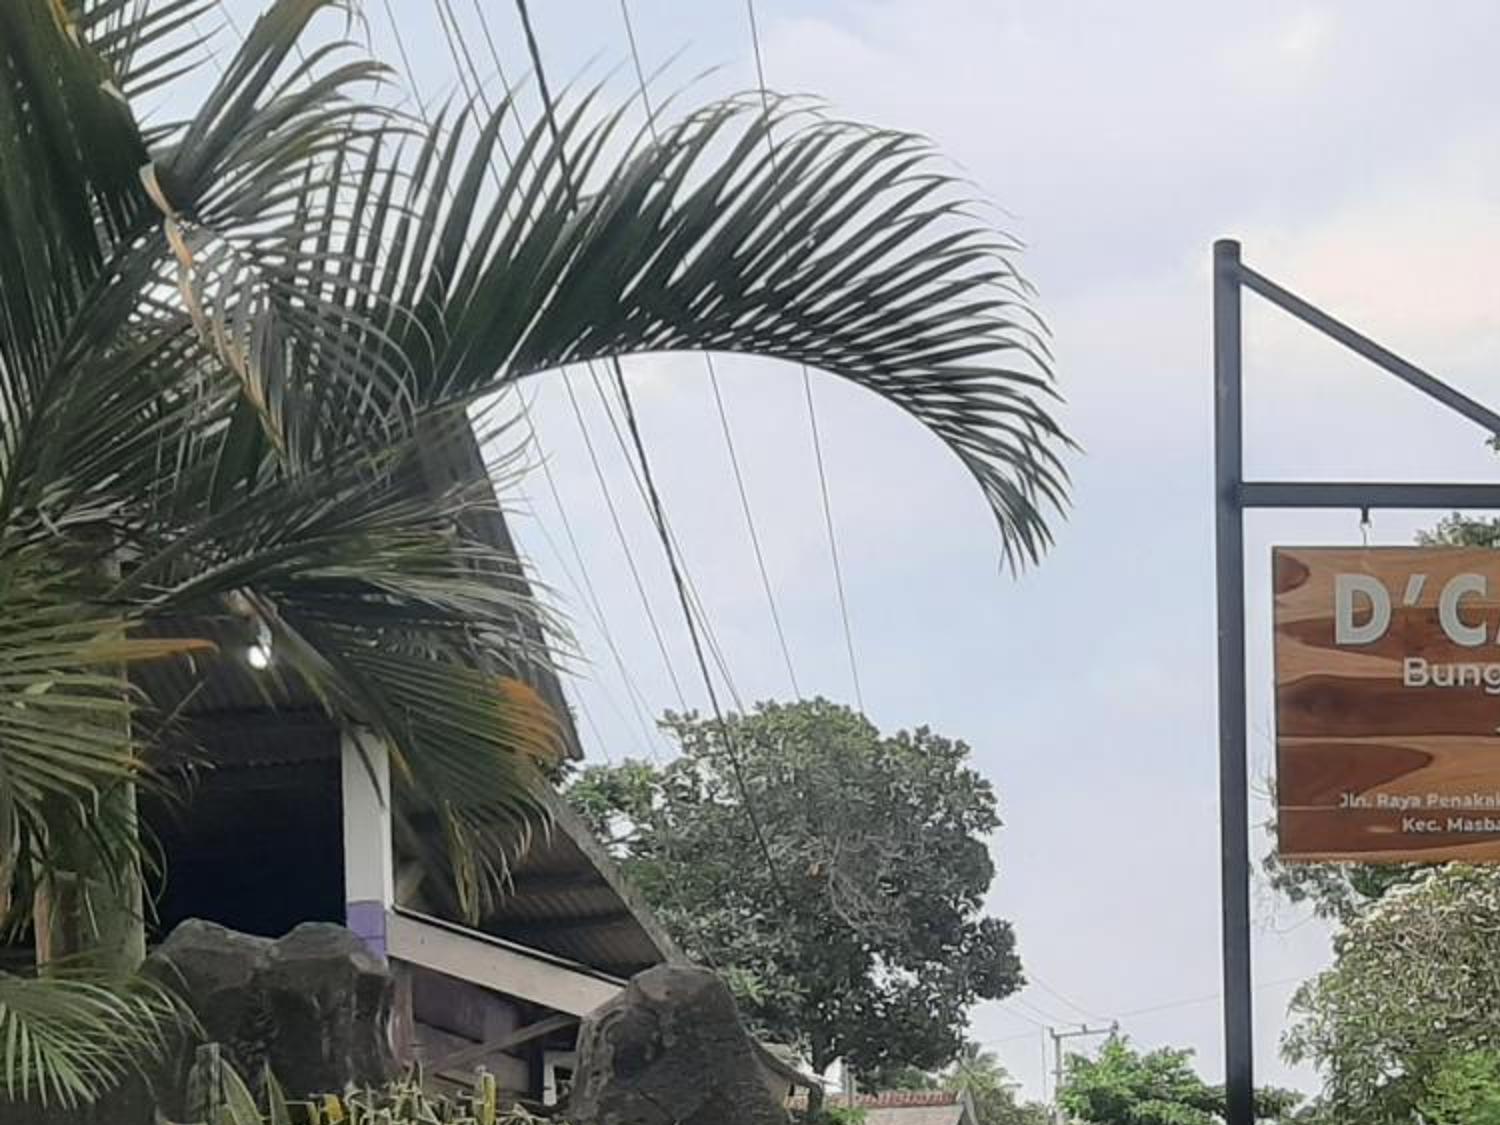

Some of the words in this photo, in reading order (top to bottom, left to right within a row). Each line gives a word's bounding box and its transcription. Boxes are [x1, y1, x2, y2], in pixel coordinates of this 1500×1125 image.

[1340, 793, 1371, 808] Jln.
[1377, 793, 1421, 809] Raya
[1403, 817, 1441, 832] Kec.
